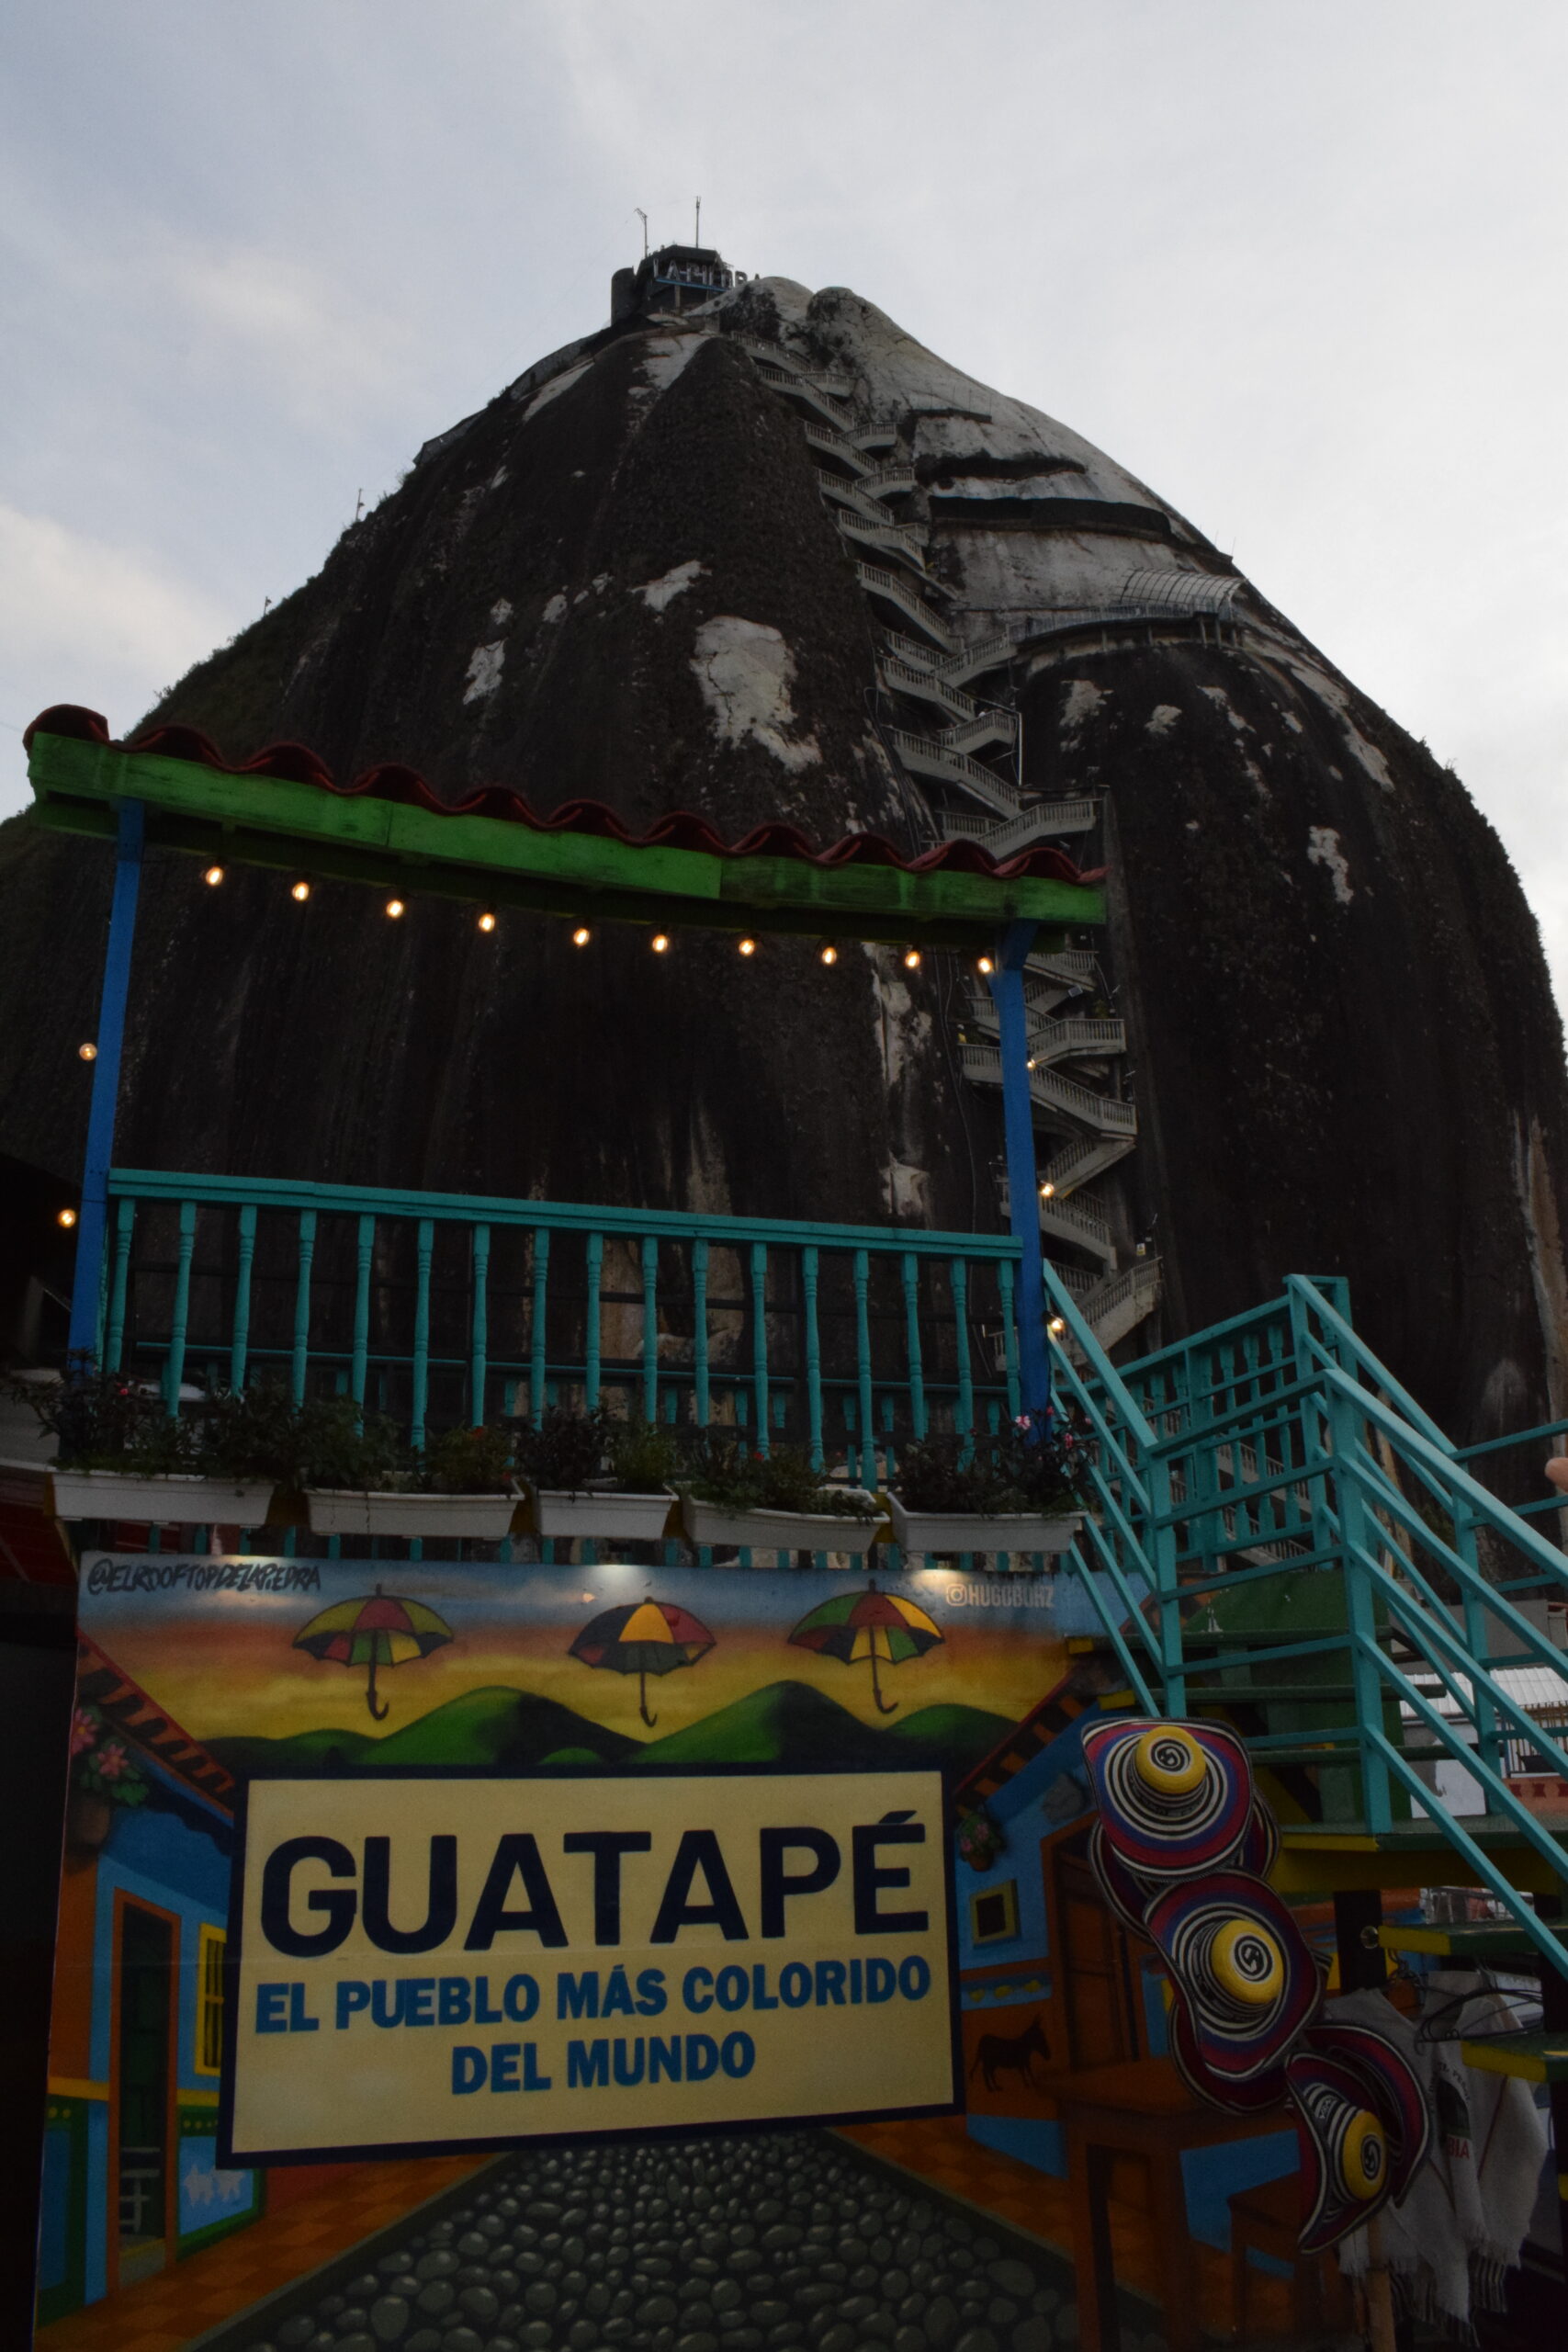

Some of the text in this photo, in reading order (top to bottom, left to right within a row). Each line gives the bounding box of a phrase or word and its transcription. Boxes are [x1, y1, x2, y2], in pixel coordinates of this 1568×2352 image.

[261, 1810, 930, 1957] GUATAPÉ
[255, 1955, 931, 2033] EL PUEBLO MÁS COLORIDO
[452, 2030, 757, 2095] DEL MUNDO
